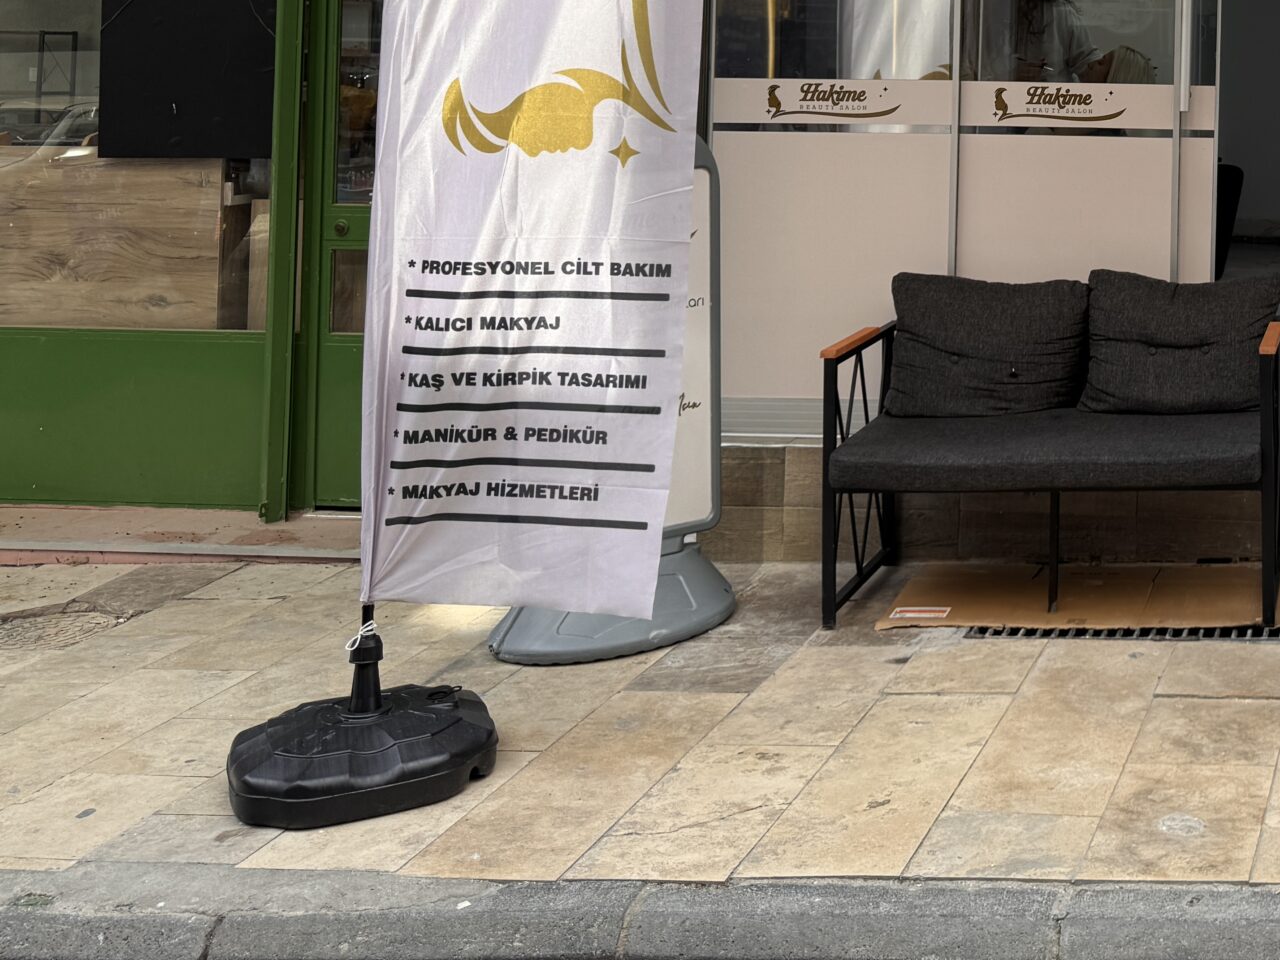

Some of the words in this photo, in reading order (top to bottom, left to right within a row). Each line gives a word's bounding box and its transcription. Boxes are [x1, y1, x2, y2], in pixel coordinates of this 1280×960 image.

[799, 82, 867, 107] Hakime
[1025, 86, 1093, 110] Hakime
[421, 259, 555, 276] PROFESYONEL
[561, 257, 604, 276] CİLT
[609, 262, 672, 278] BAKIM
[415, 316, 473, 332] KALICI
[479, 316, 561, 331] MAKYAJ
[407, 372, 444, 392] KAŞ
[451, 371, 477, 387] VE
[482, 367, 552, 387] KİRPİK
[557, 371, 647, 389] TASARIMI
[403, 426, 496, 445] MANİKÜR
[503, 426, 518, 441] &
[524, 425, 608, 445] PEDİKÜR
[402, 482, 480, 500] MAKYAJ
[486, 479, 600, 502] HİZMETLERİ
